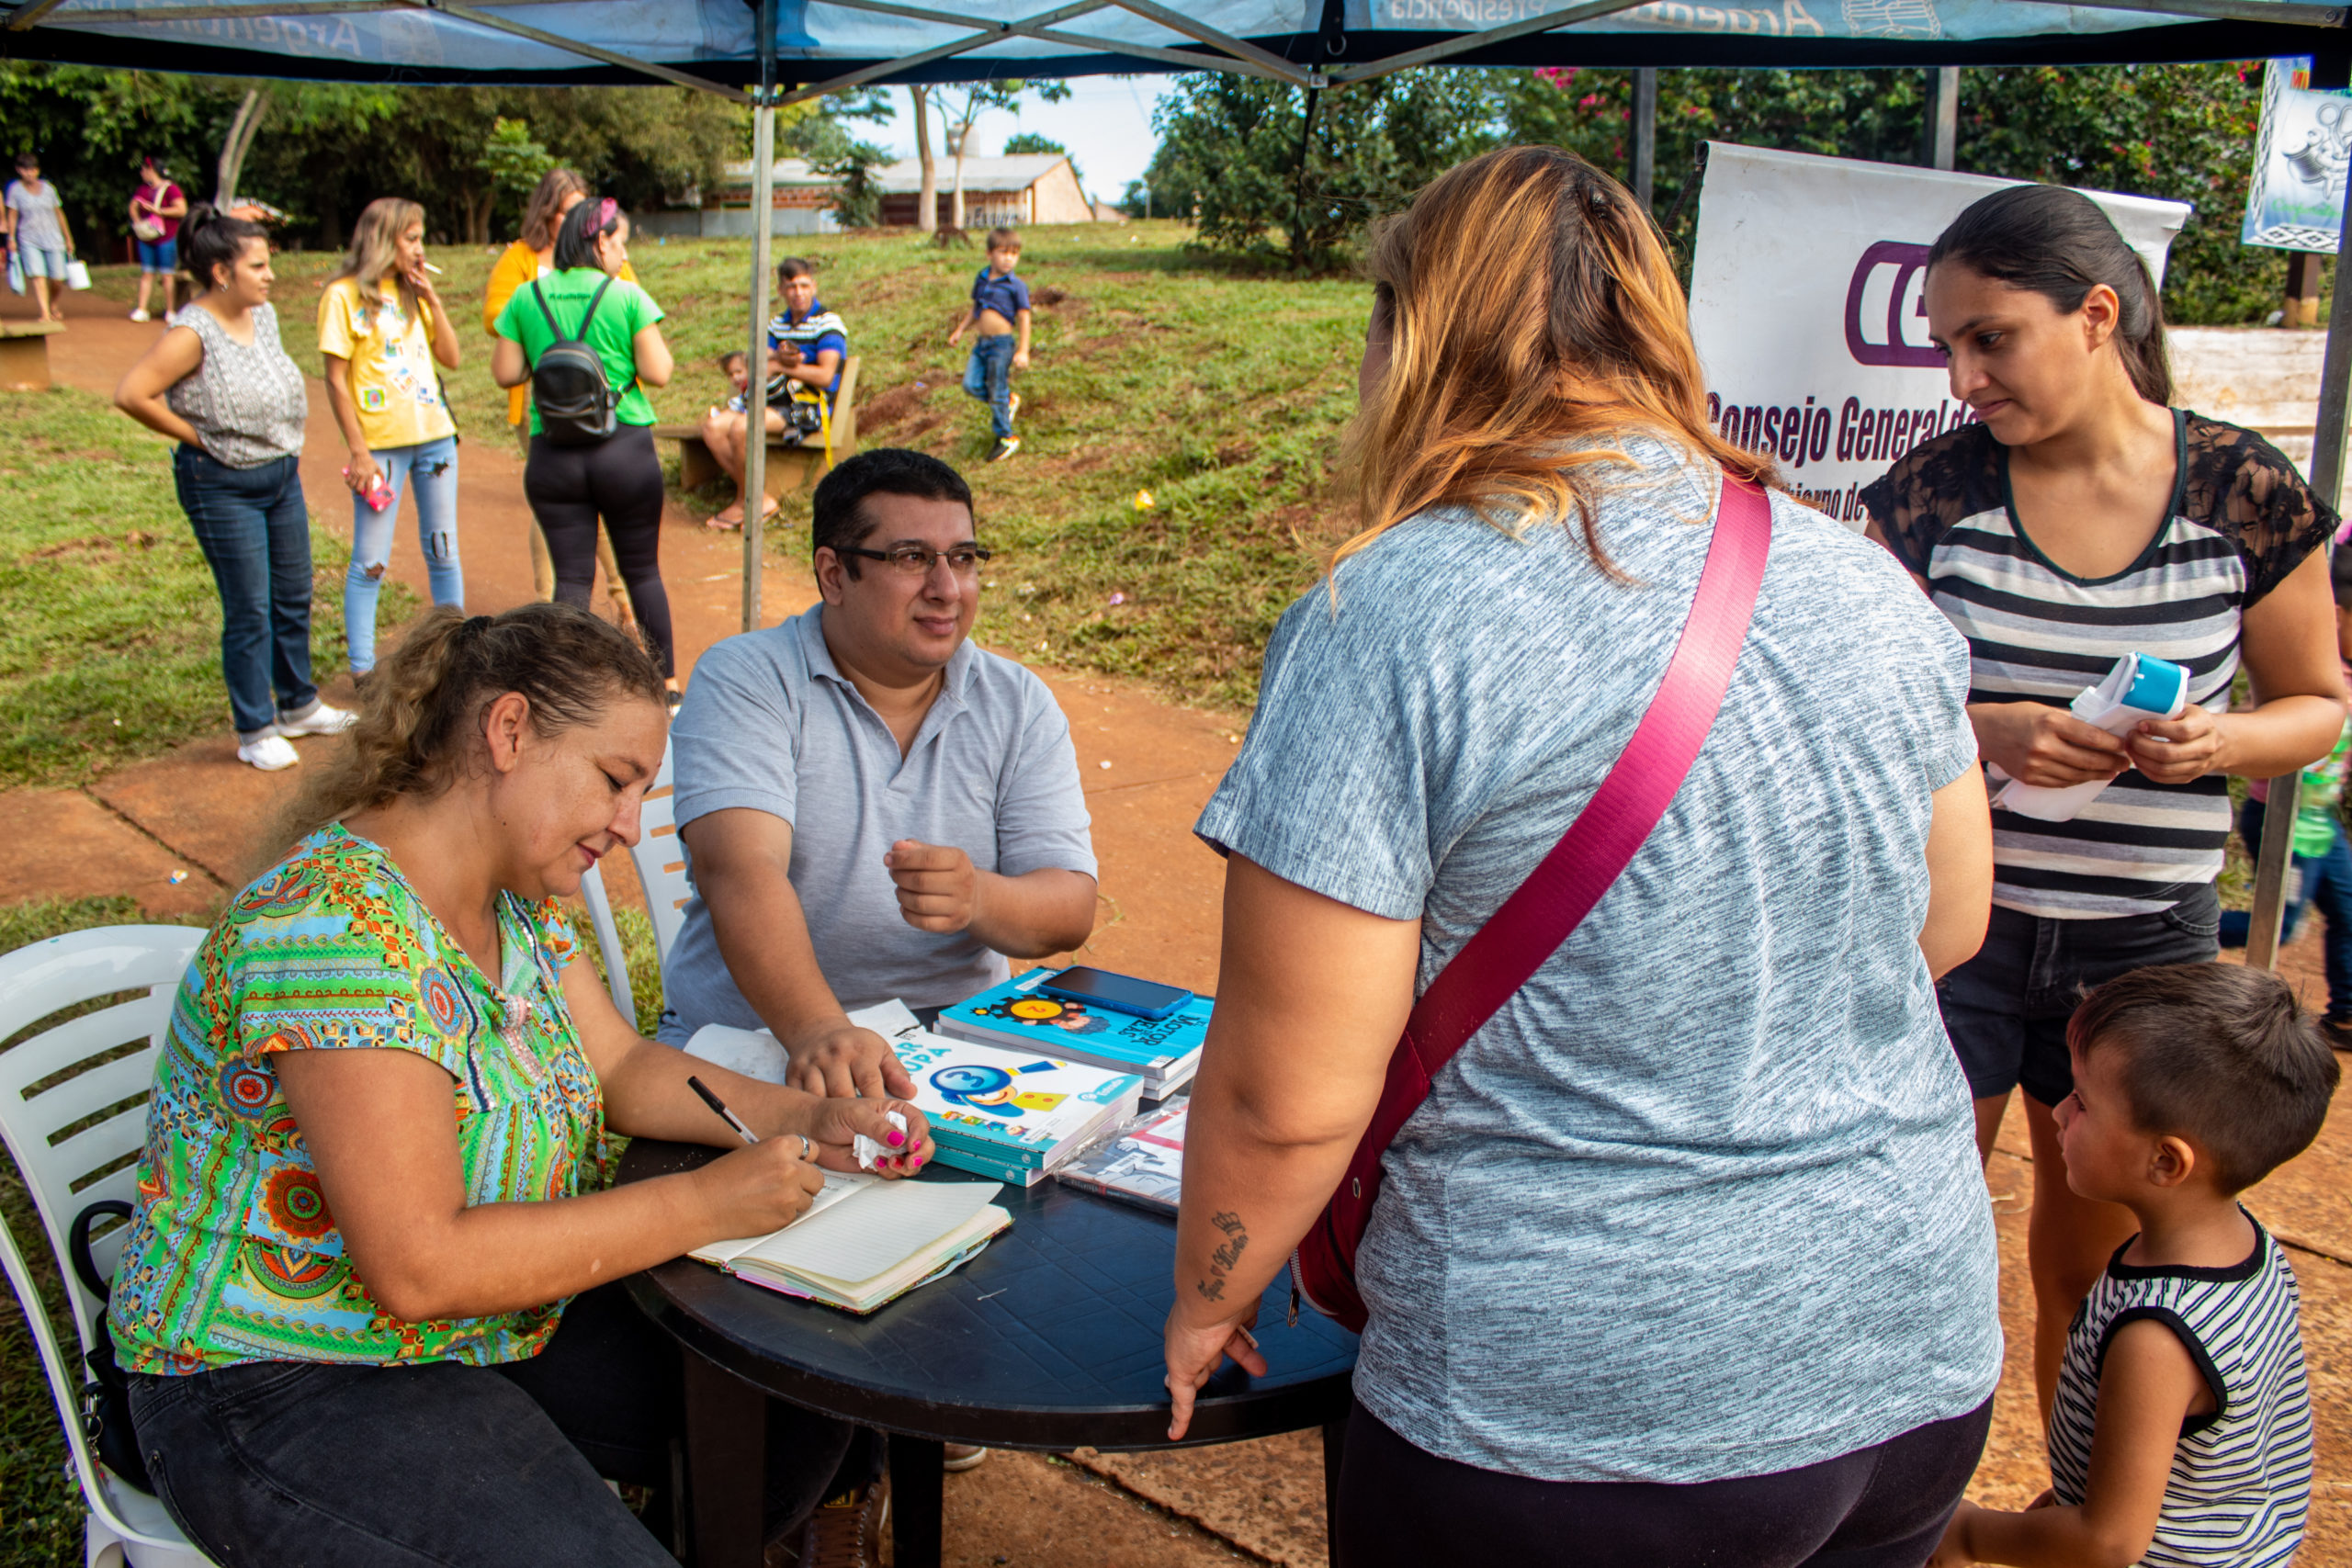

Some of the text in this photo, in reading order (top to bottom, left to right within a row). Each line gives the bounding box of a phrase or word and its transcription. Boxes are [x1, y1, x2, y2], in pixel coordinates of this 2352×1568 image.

[1836, 396, 1949, 462] General
[1130, 1014, 1201, 1045] MOTOR
[903, 1048, 952, 1076] UPA
[944, 1070, 986, 1089] 3
